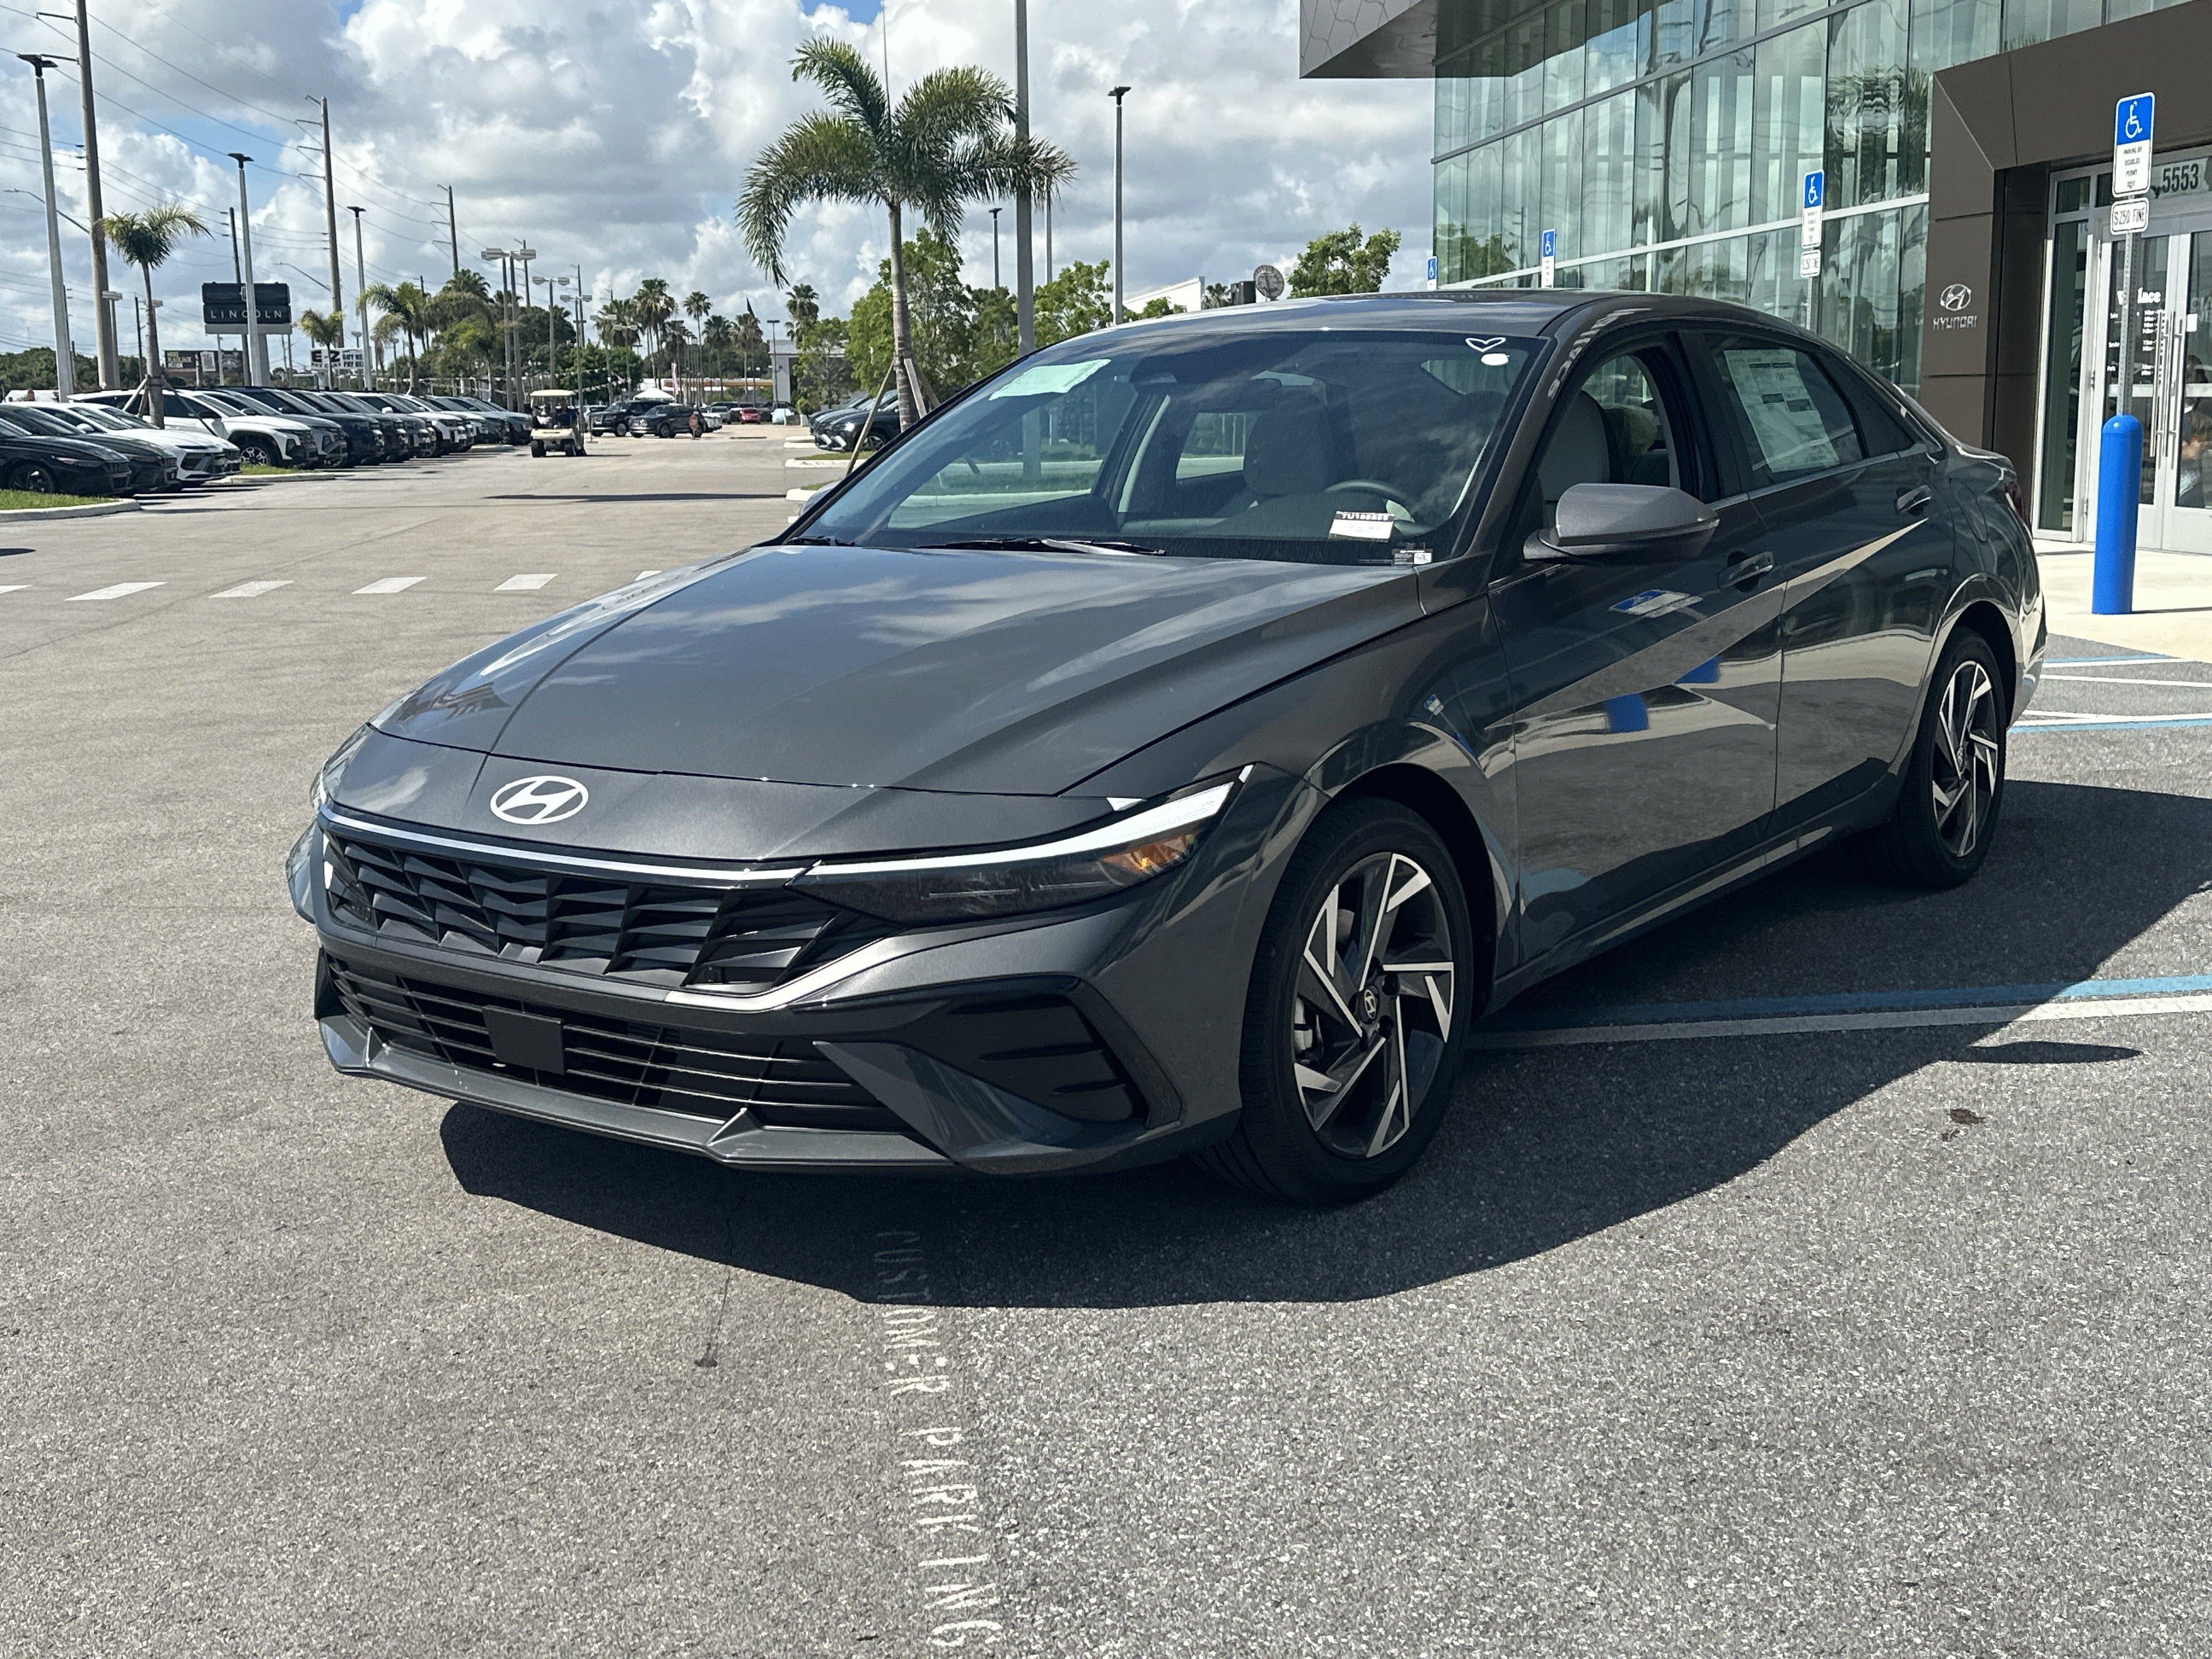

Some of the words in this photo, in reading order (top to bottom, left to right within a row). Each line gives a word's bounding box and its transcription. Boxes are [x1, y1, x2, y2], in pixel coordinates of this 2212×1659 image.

[2163, 163, 2199, 193] 5553
[1933, 315, 1978, 331] HYUNDAI
[899, 1426, 1002, 1648] PARKING
